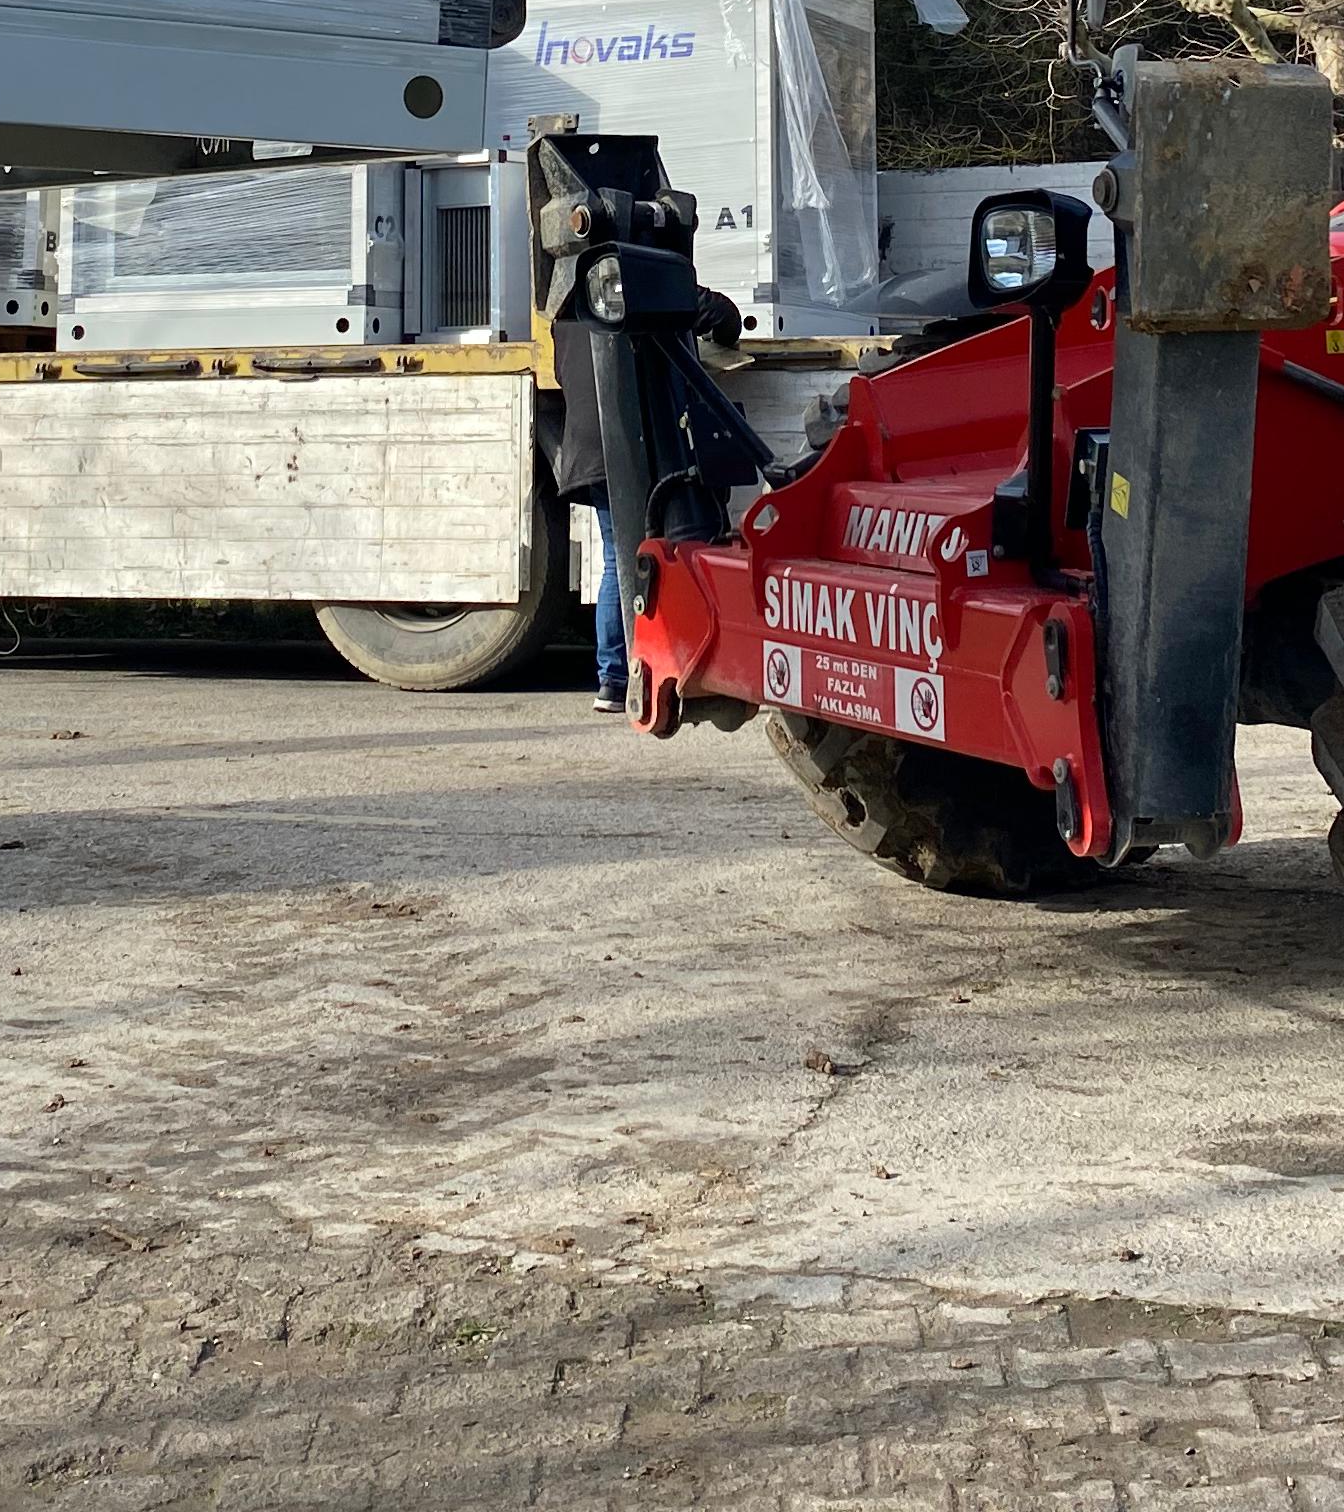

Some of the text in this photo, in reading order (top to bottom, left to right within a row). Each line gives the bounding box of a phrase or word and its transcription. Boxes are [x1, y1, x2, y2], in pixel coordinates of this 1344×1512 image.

[534, 20, 697, 66] Inovaks
[714, 204, 754, 231] A1
[763, 566, 944, 674] SİMAK VİNÇ
[815, 654, 878, 681] 25 mt DEN
[827, 676, 867, 699] FAZLA
